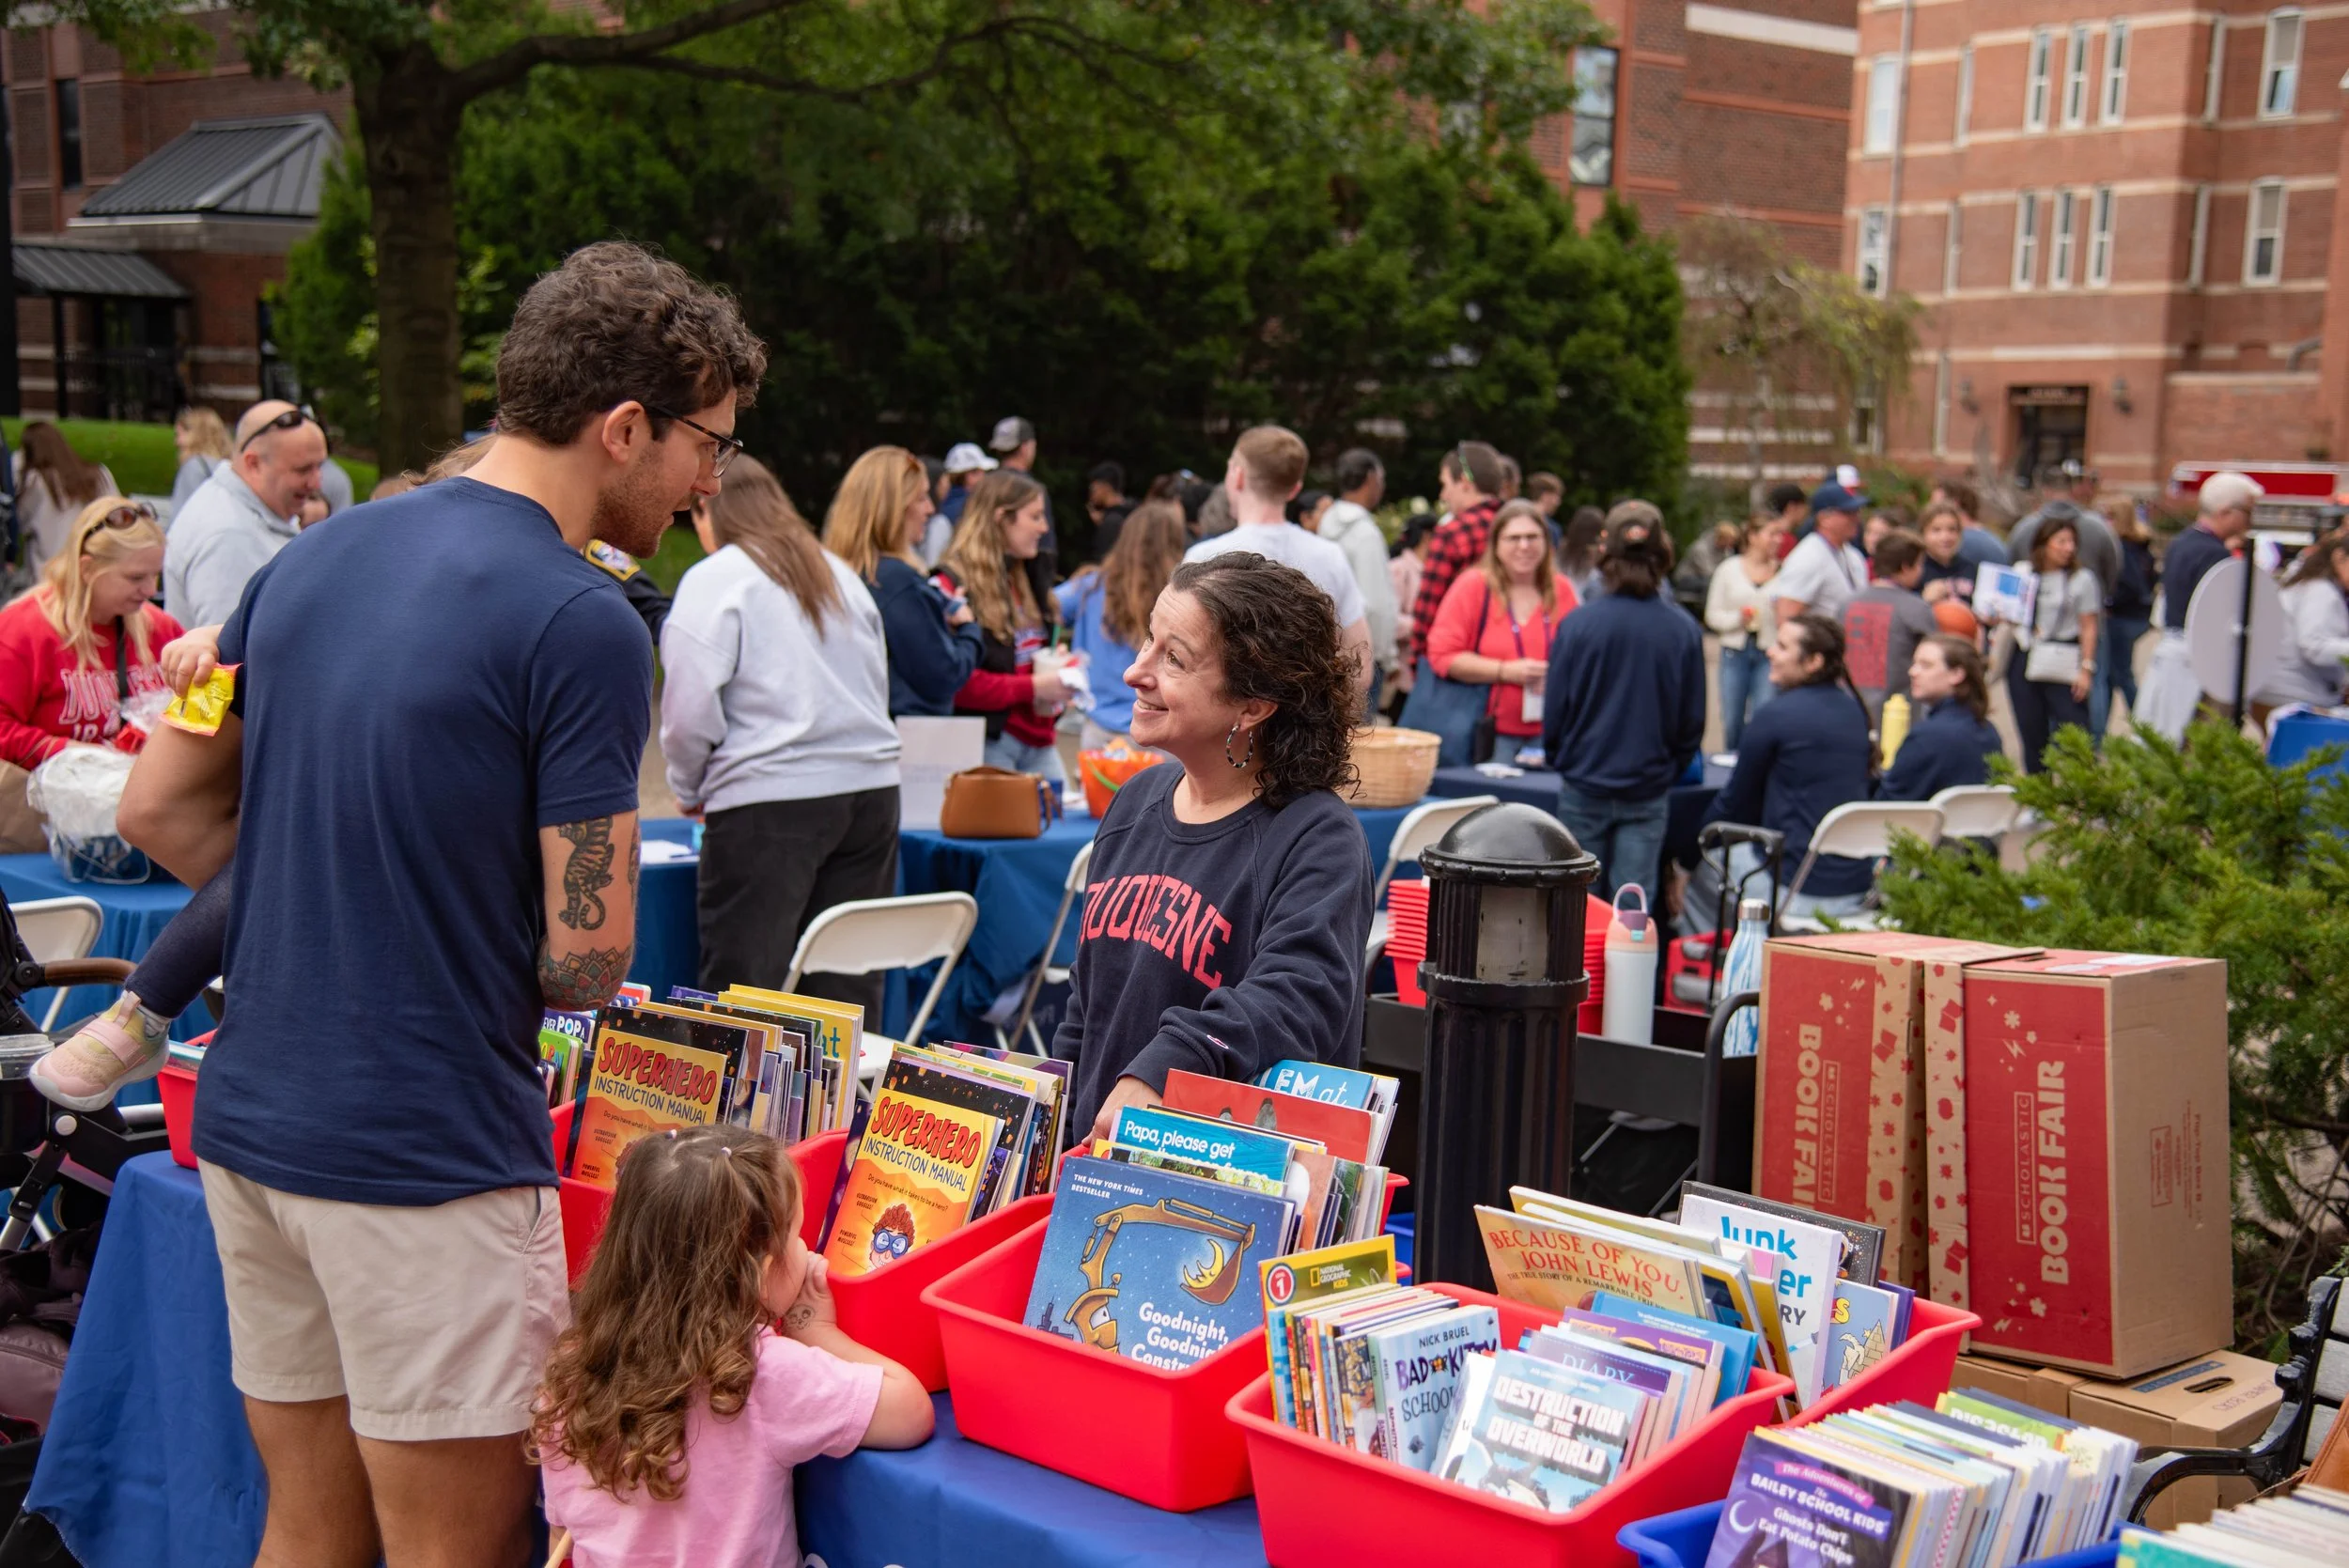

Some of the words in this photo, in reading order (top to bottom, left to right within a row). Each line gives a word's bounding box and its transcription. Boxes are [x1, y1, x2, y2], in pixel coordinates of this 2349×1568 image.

[556, 1015, 583, 1038] POP
[598, 1036, 718, 1106] SUPERHERO
[1795, 1023, 1822, 1137] BOOK
[594, 1075, 665, 1112] INSTRUCTION
[1317, 1080, 1348, 1106] at
[2037, 1060, 2066, 1158] FAIR
[603, 1110, 612, 1118] Do
[620, 1115, 631, 1126] have
[631, 1120, 644, 1129] what
[870, 1095, 981, 1169] SUPERHERO
[1124, 1120, 1161, 1147] Papa,
[1160, 1130, 1209, 1155] please
[1208, 1140, 1237, 1160] get
[1821, 1082, 1836, 1198] SCHOLASTIC
[2019, 1097, 2030, 1221] SCHOLASTIC
[863, 1136, 930, 1175] INSTRUCTION
[928, 1161, 970, 1192] MANUAL
[1793, 1138, 1818, 1211] FAI
[867, 1172, 876, 1182] Do
[874, 1177, 883, 1186] you
[882, 1180, 894, 1190] have
[893, 1185, 906, 1195] what
[909, 1189, 922, 1202] takes
[921, 1195, 927, 1203] to
[936, 1203, 950, 1213] hero?
[1071, 1184, 1112, 1200] BESTSELLER
[1074, 1173, 1087, 1184] THE
[1087, 1177, 1104, 1188] NEW
[1103, 1180, 1124, 1192] YORK
[1123, 1184, 1144, 1196] TIMES
[2038, 1163, 2070, 1286] BOOK
[1488, 1230, 1586, 1255] BECAUSE
[1592, 1241, 1623, 1265] OF
[1276, 1277, 1286, 1298] 1
[1319, 1263, 1346, 1275] NATIONAL
[1319, 1268, 1353, 1284] GEOGRAPHIC
[1332, 1278, 1349, 1290] KIDS
[1508, 1272, 1519, 1281] THE
[1520, 1270, 1536, 1280] TRUE
[1537, 1270, 1562, 1280] STORY
[1562, 1274, 1573, 1282] OF
[1575, 1276, 1582, 1284] A
[1582, 1279, 1637, 1300] REMARKABLE
[1520, 1250, 1579, 1274] JOHN
[1585, 1259, 1654, 1298] LEWIS
[1138, 1301, 1230, 1346] Goodnight,
[1146, 1326, 1223, 1359] Goodni
[1419, 1333, 1441, 1348] NICK
[1442, 1326, 1470, 1343] BRUEL
[1394, 1356, 1429, 1391] BAD
[1492, 1374, 1627, 1438] DESTRUCTION
[1532, 1411, 1551, 1429] OF
[1551, 1419, 1575, 1438] THE
[1486, 1415, 1608, 1475] OVERWORLD
[1782, 1464, 1800, 1476] The
[1801, 1468, 1855, 1497] Adventures
[1854, 1491, 1868, 1503] of
[1813, 1486, 1828, 1498] The
[1750, 1472, 1797, 1500] BAILEY
[1796, 1490, 1852, 1522] SCHOOL
[1851, 1511, 1888, 1535] KIDS
[1758, 1517, 1779, 1536] Eat
[1779, 1527, 1818, 1552] Potato
[1819, 1542, 1856, 1568] Chips
[1773, 1506, 1815, 1532] Ghosts
[1815, 1522, 1850, 1547] Don't
